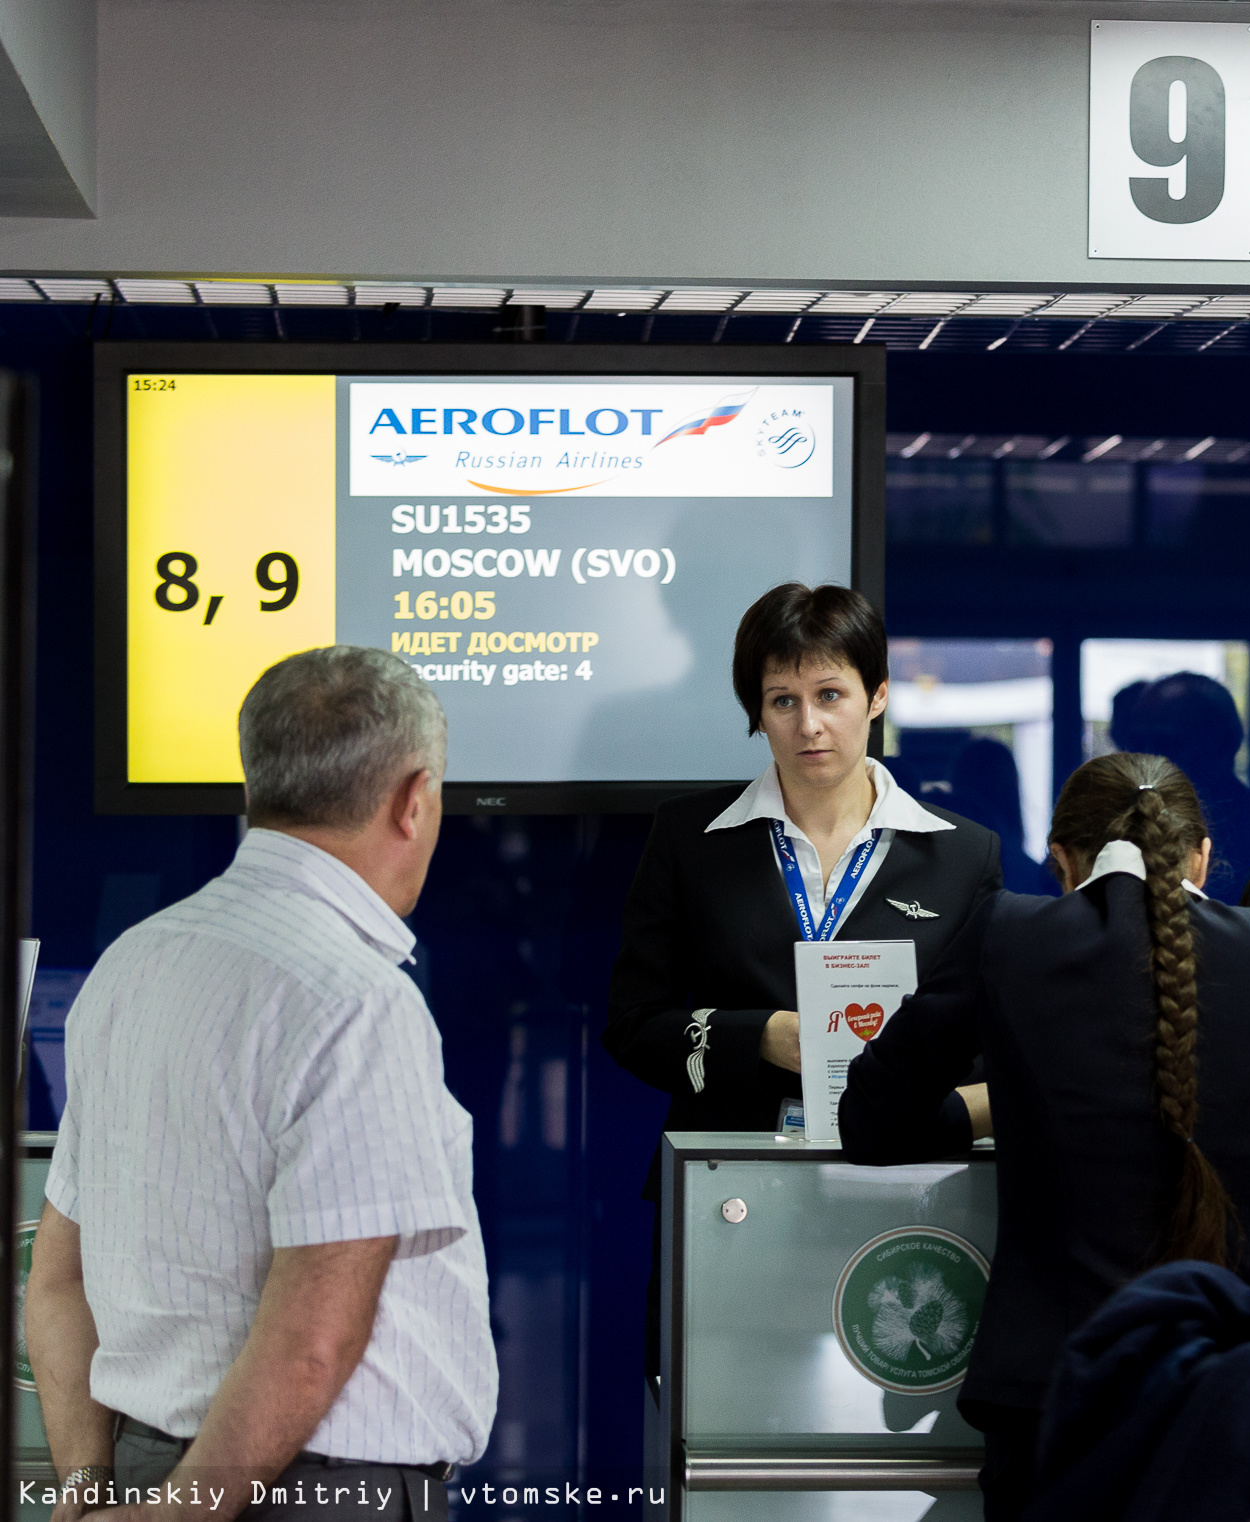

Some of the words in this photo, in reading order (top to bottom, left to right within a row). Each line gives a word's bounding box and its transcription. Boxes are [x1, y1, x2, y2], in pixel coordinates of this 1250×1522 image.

[1129, 55, 1226, 224] 9
[133, 379, 177, 392] 15:24
[369, 408, 663, 436] AEROFLOT
[455, 450, 542, 470] Russian
[556, 450, 644, 470] Airlines
[391, 504, 531, 534] SU1535
[391, 549, 561, 578] MOSCOW
[571, 548, 677, 584] (SVO)
[154, 552, 225, 626] 8,
[255, 552, 300, 612] 9
[393, 591, 496, 620] 16:05
[391, 632, 462, 655] ИДЕТ
[467, 632, 599, 655] ДОСМОТР
[404, 659, 497, 686] ecurity
[502, 663, 568, 686] gate:
[574, 660, 593, 681] 4
[476, 797, 507, 806] NEC
[850, 838, 875, 879] AEROFLO
[826, 1011, 844, 1033] Я
[876, 1242, 920, 1262] СИБИРСКОЕ
[922, 1242, 961, 1263] КАЧЕСТВО
